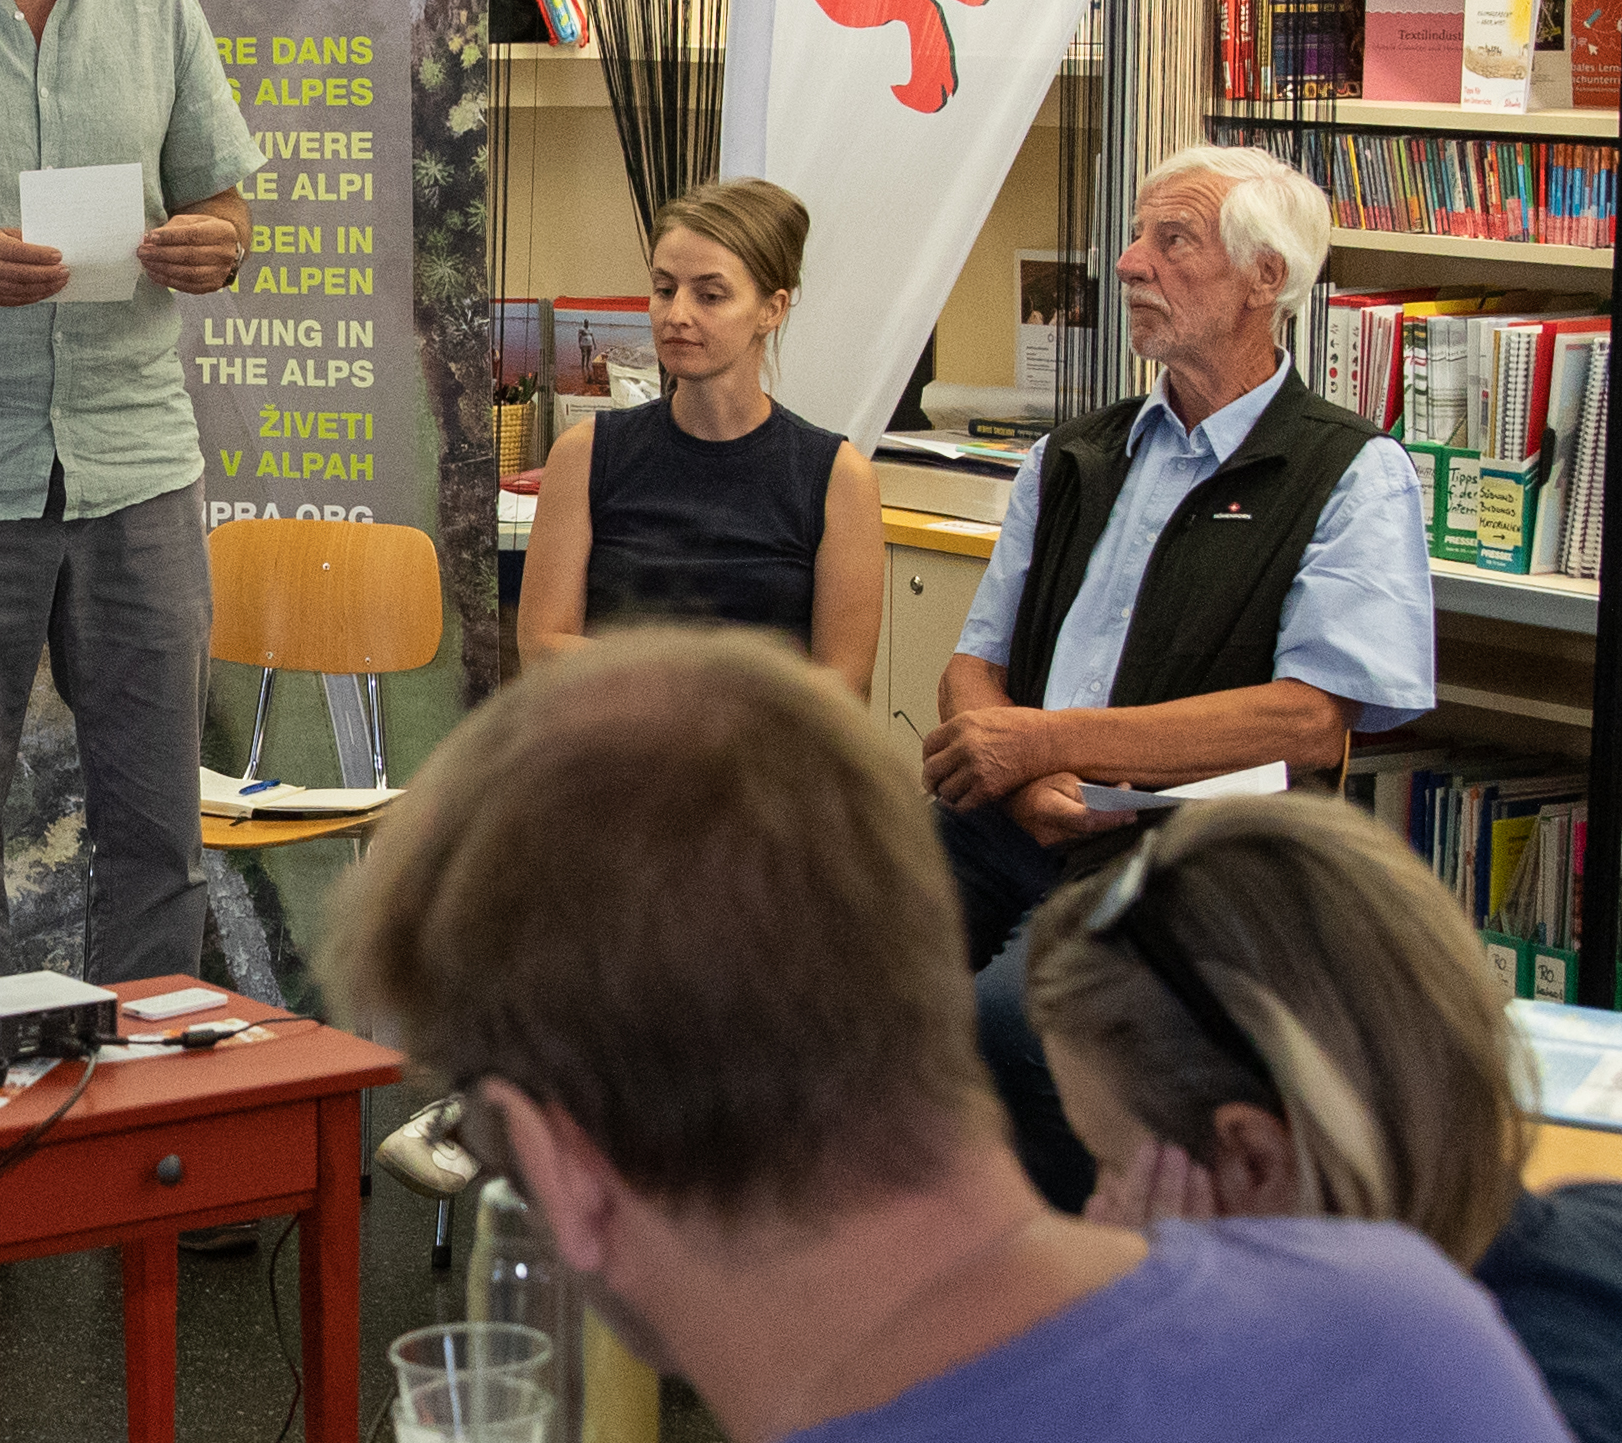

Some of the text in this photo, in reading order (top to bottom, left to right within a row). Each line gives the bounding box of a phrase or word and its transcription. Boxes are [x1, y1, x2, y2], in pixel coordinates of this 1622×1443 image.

[272, 36, 374, 65] DANS
[254, 78, 374, 107] ALPES
[291, 172, 373, 201] ALPI
[337, 226, 373, 254] IN
[254, 266, 373, 295] ALPEN
[204, 318, 373, 348] LIVING IN
[195, 356, 374, 387] THE ALPS
[259, 404, 373, 441] ŽIVETI
[256, 452, 374, 482] ALPAH
